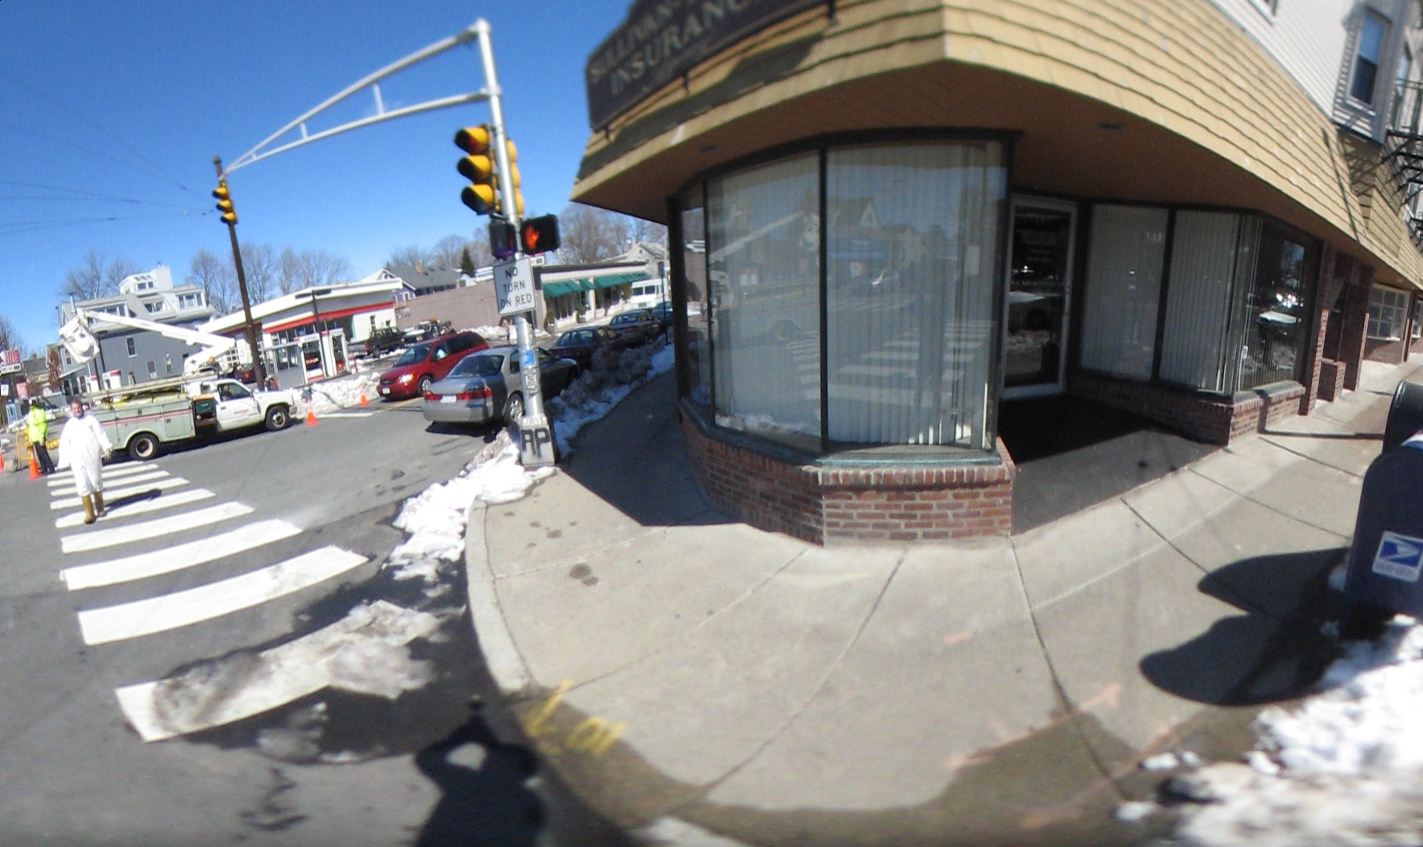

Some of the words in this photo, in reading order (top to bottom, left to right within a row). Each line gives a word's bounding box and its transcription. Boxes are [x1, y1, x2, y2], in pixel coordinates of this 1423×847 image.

[505, 266, 519, 279] NO
[503, 280, 526, 294] TURN
[500, 298, 512, 309] ON
[515, 292, 532, 308] RED
